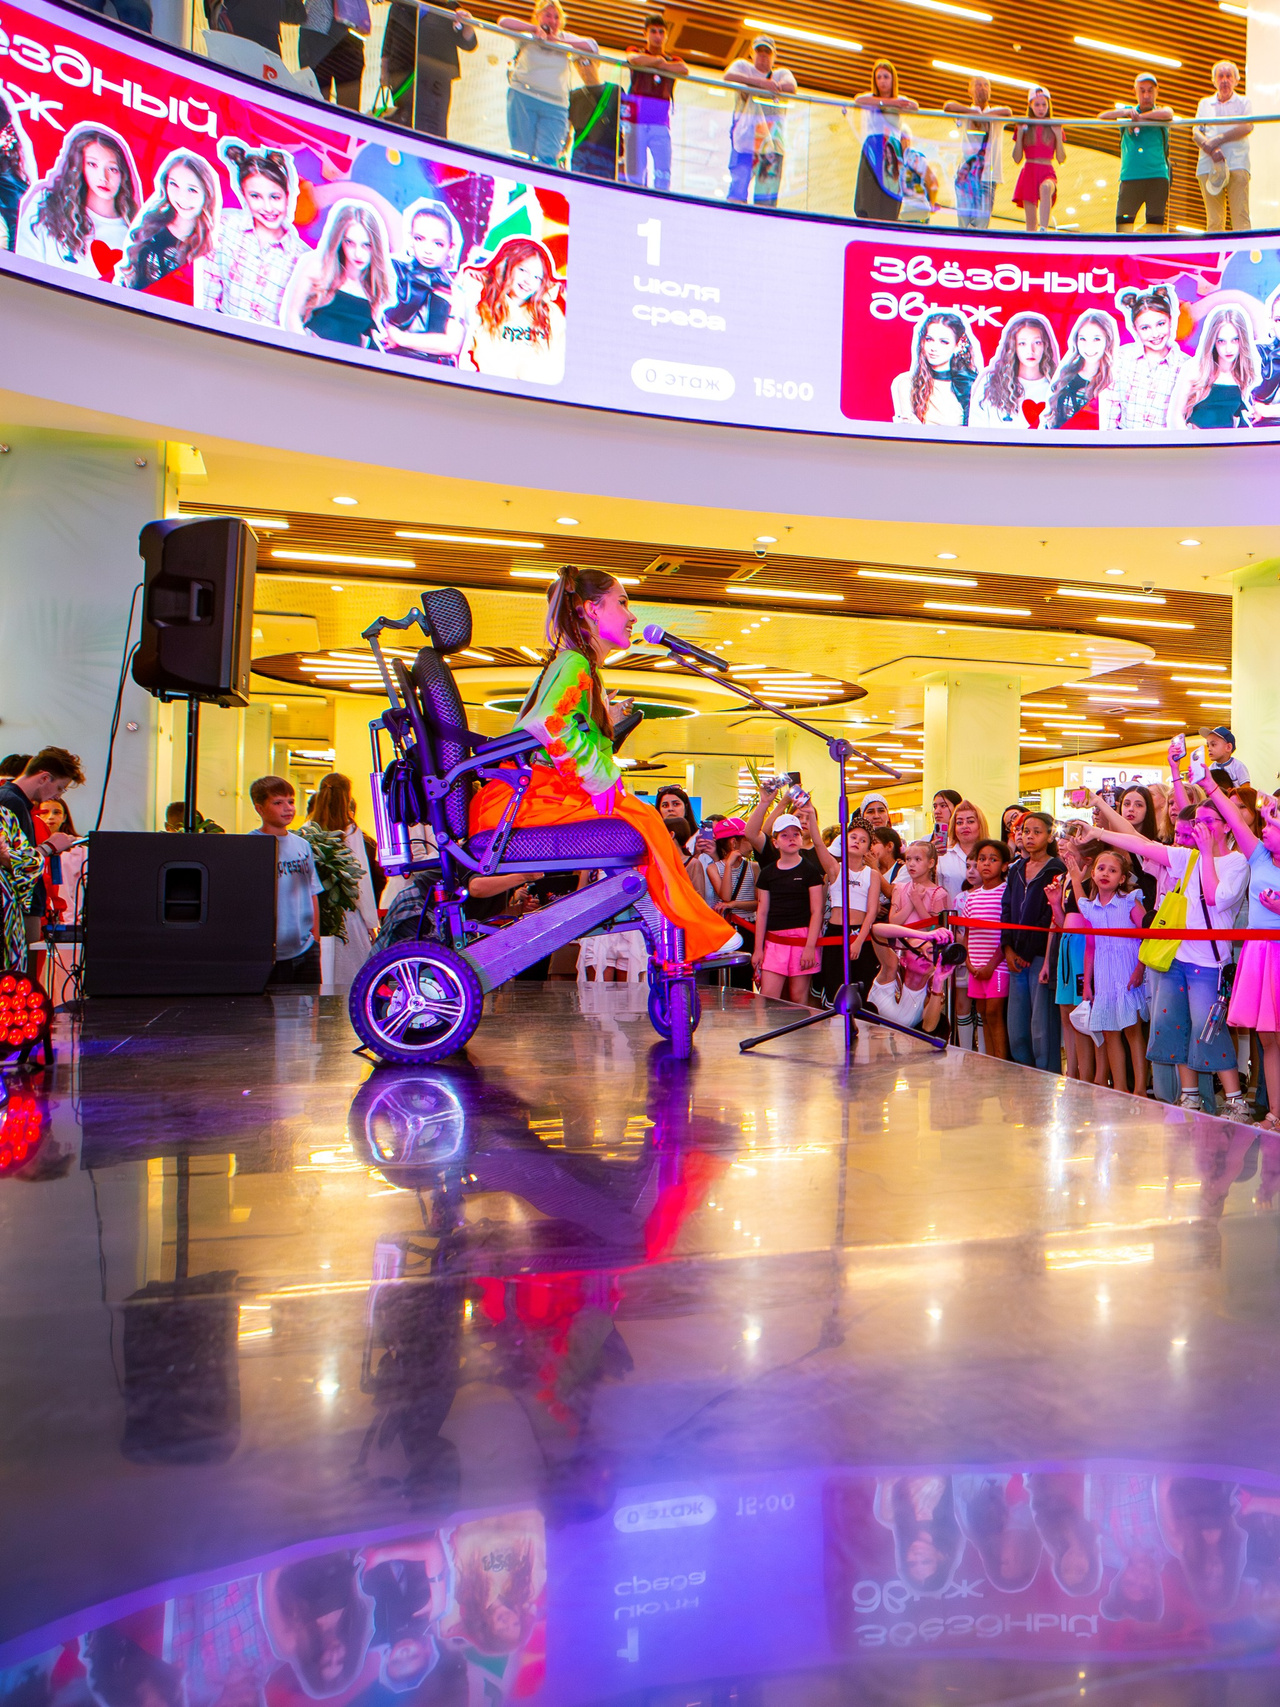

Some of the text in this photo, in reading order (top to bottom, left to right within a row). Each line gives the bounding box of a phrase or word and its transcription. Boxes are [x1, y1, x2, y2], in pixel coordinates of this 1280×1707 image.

[636, 217, 662, 266] 1
[870, 255, 1116, 294] Звёздный
[633, 275, 721, 303] июля
[632, 304, 727, 332] среда
[869, 291, 1004, 328] двж
[645, 368, 721, 391] 0 этаж
[753, 377, 814, 401] 15:00
